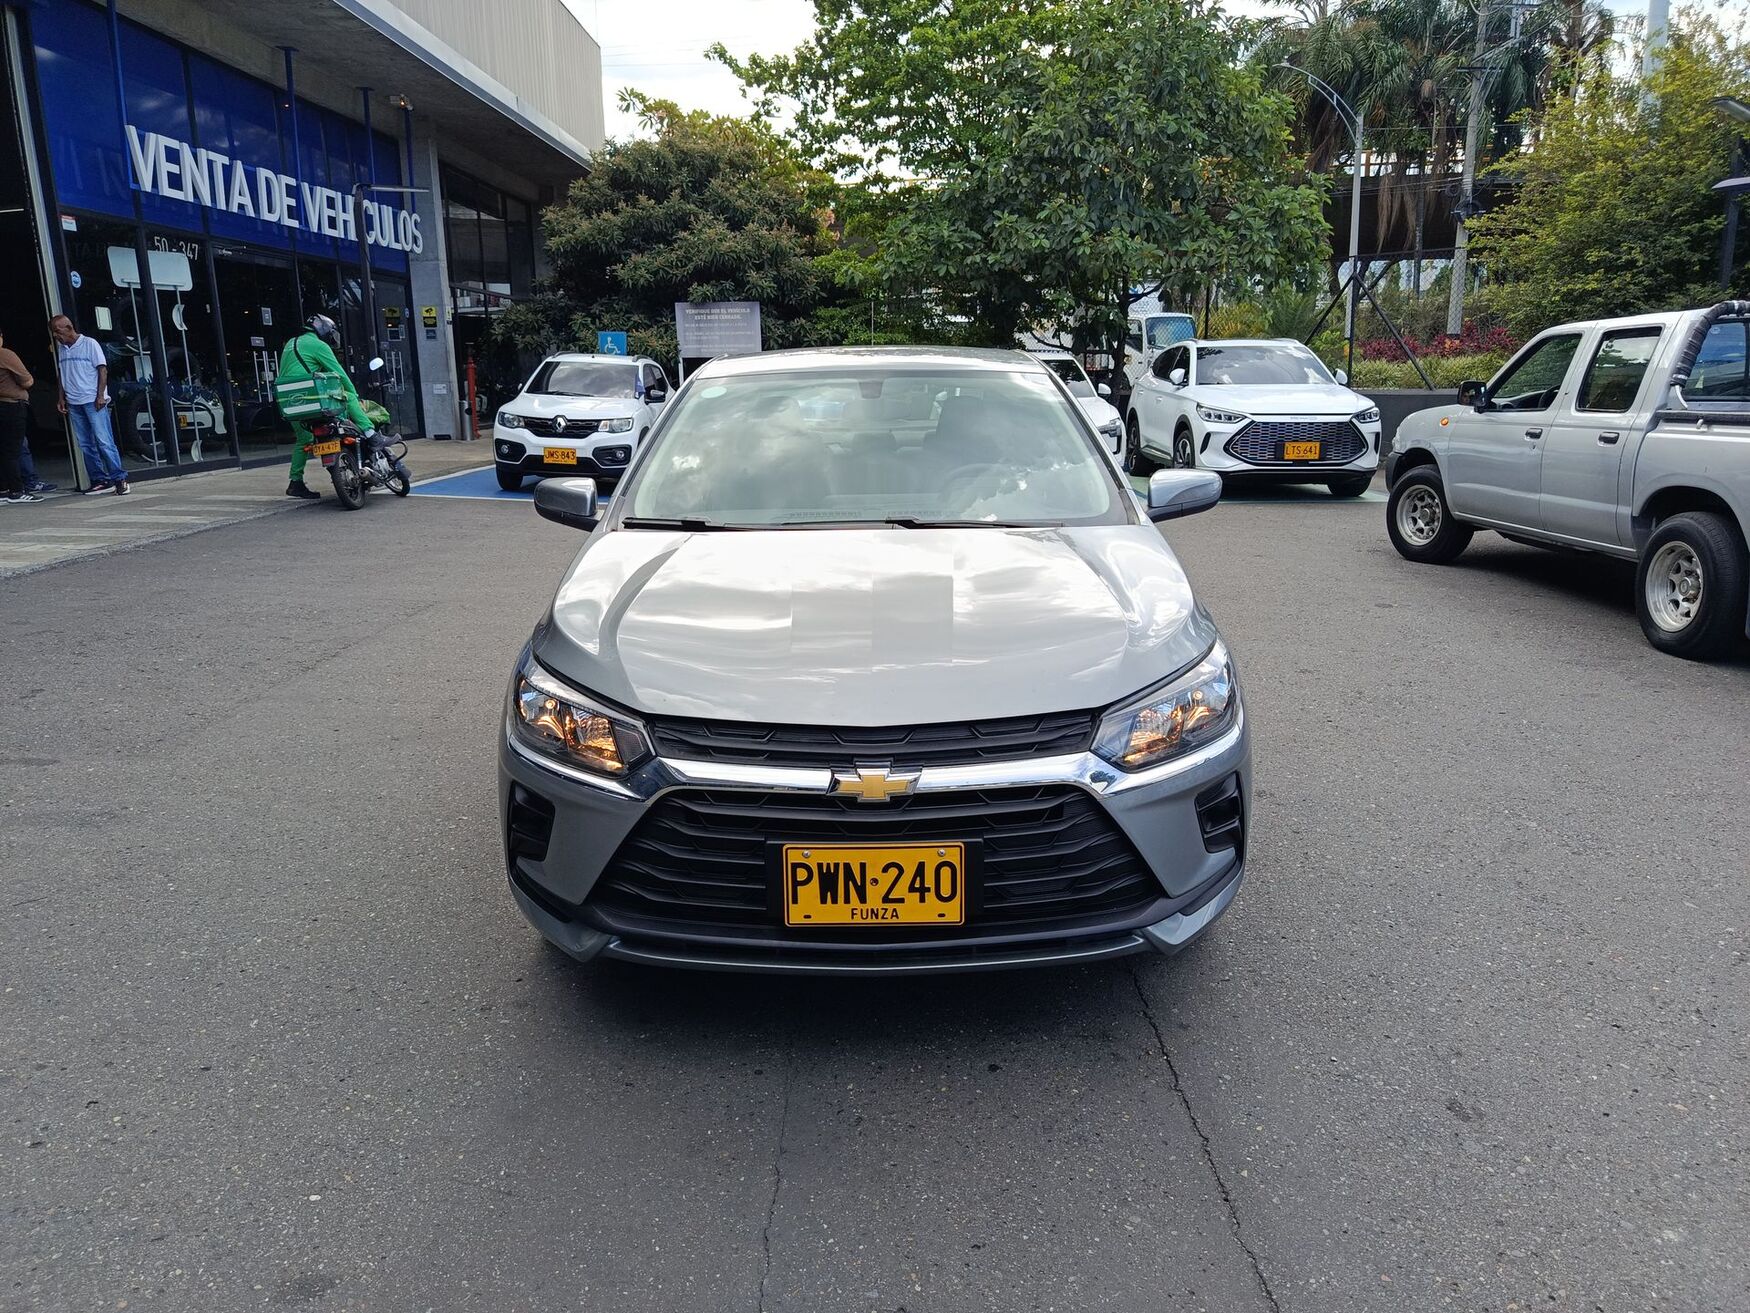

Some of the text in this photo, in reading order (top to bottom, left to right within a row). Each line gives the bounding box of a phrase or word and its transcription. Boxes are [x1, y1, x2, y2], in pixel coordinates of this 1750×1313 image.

[125, 124, 423, 254] VENTA DE VEHCULOS
[850, 907, 900, 920] FUNZA
